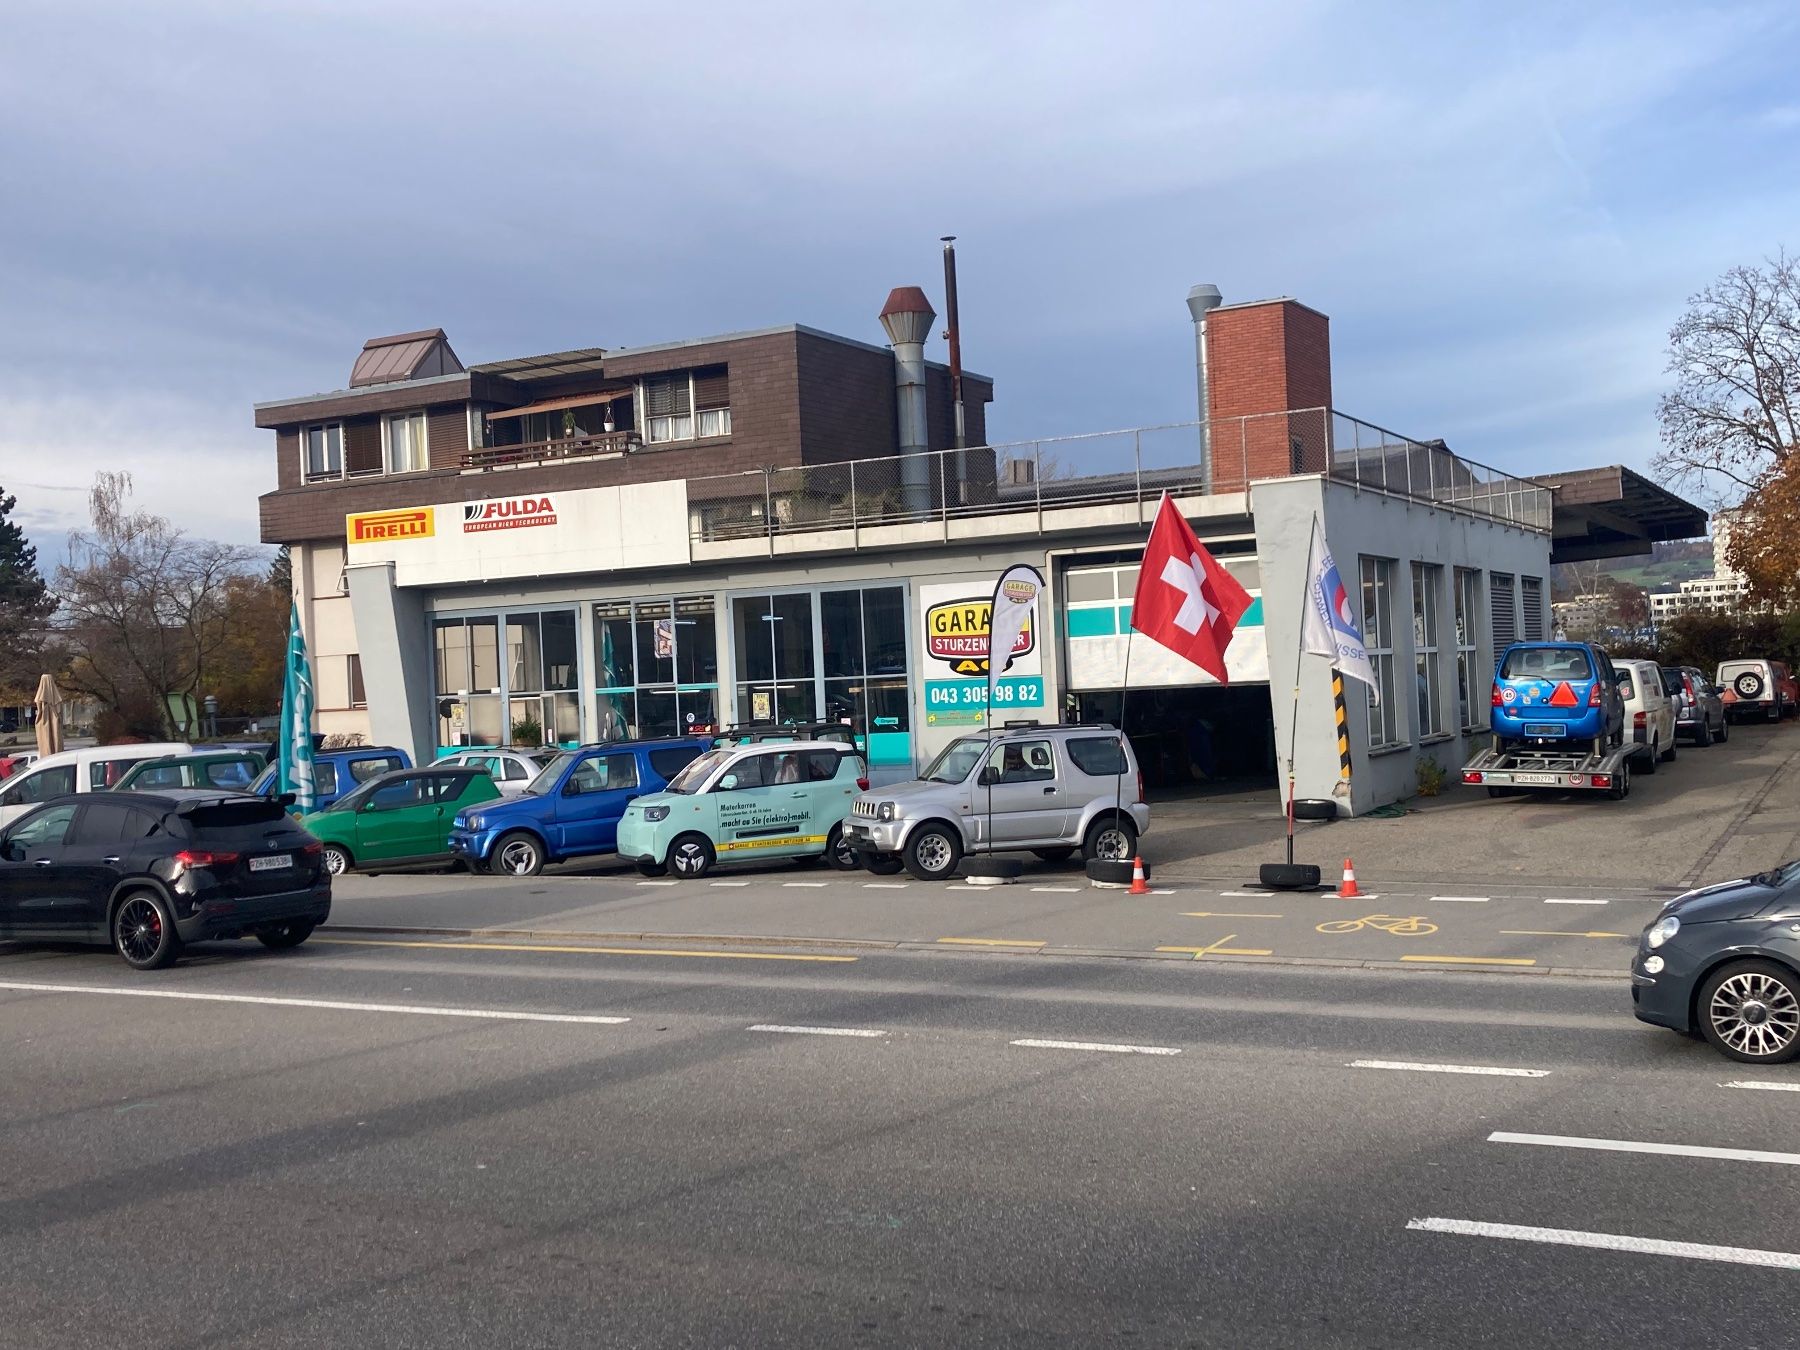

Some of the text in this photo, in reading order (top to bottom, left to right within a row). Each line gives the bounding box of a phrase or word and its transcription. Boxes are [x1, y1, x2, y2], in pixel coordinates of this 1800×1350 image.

[481, 498, 554, 519] FULDA
[355, 512, 426, 540] PIRELLI
[464, 516, 556, 531] EUROPEAN HIGH TECHNOLOGY
[1006, 583, 1033, 592] GARAGE
[931, 684, 1038, 704] 043 305 98 82
[752, 816, 761, 825] Sie
